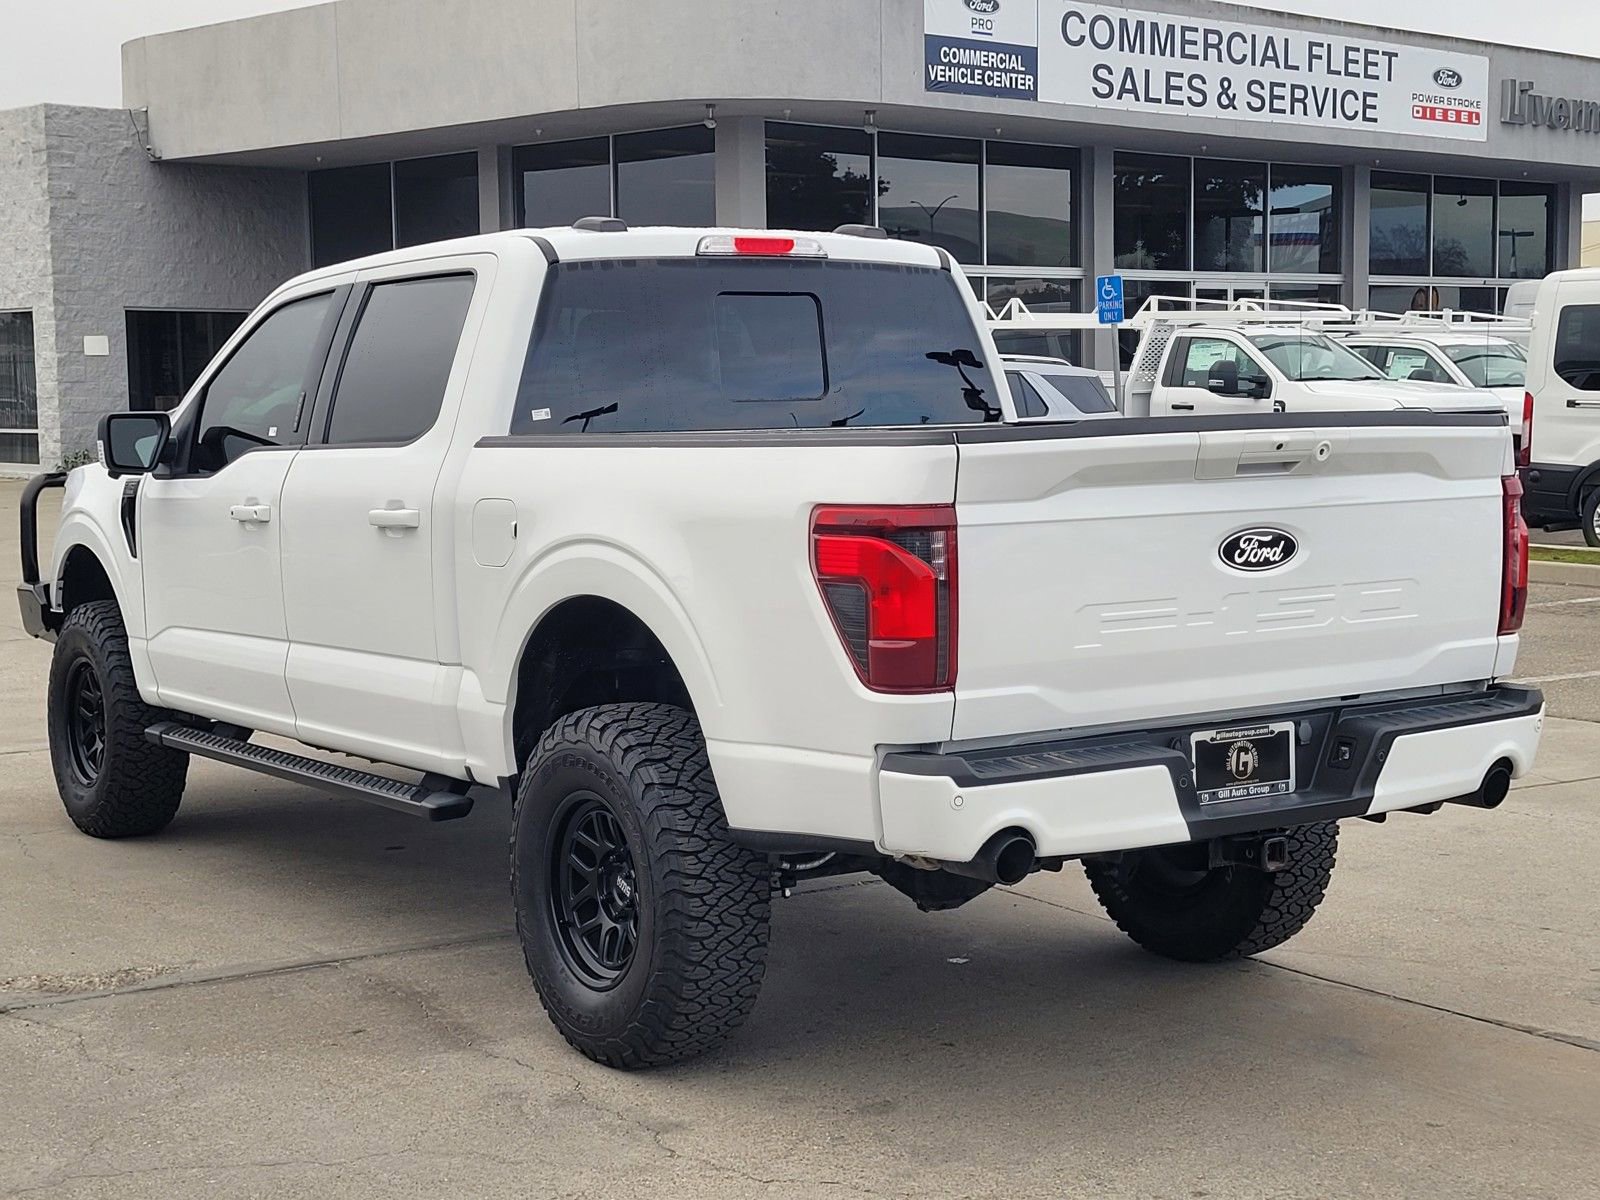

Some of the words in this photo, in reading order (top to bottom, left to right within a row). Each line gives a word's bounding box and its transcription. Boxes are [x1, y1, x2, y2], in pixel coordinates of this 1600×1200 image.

[971, 17, 993, 31] PRO
[1061, 10, 1300, 72] COMMERCIAL
[1307, 40, 1399, 82] FLEET
[940, 46, 1026, 72] COMMERCIAL
[928, 64, 984, 86] VEHICLE
[985, 70, 1034, 91] CENTER
[1092, 63, 1208, 109] SALES
[1216, 76, 1238, 111] &
[1246, 79, 1379, 124] SERVICE
[1412, 93, 1445, 105] POWER
[1446, 96, 1482, 109] STROKE
[1413, 106, 1479, 124] DIESEL
[1098, 300, 1122, 310] PARKING
[1103, 311, 1119, 321] ONLY
[1233, 534, 1285, 564] Ford
[1216, 728, 1269, 740] gillautogroup.com
[1228, 741, 1253, 756] AUTOMOTIVE
[1218, 790, 1230, 798] Gill
[1231, 788, 1248, 797] Auto
[1249, 786, 1269, 794] Group
